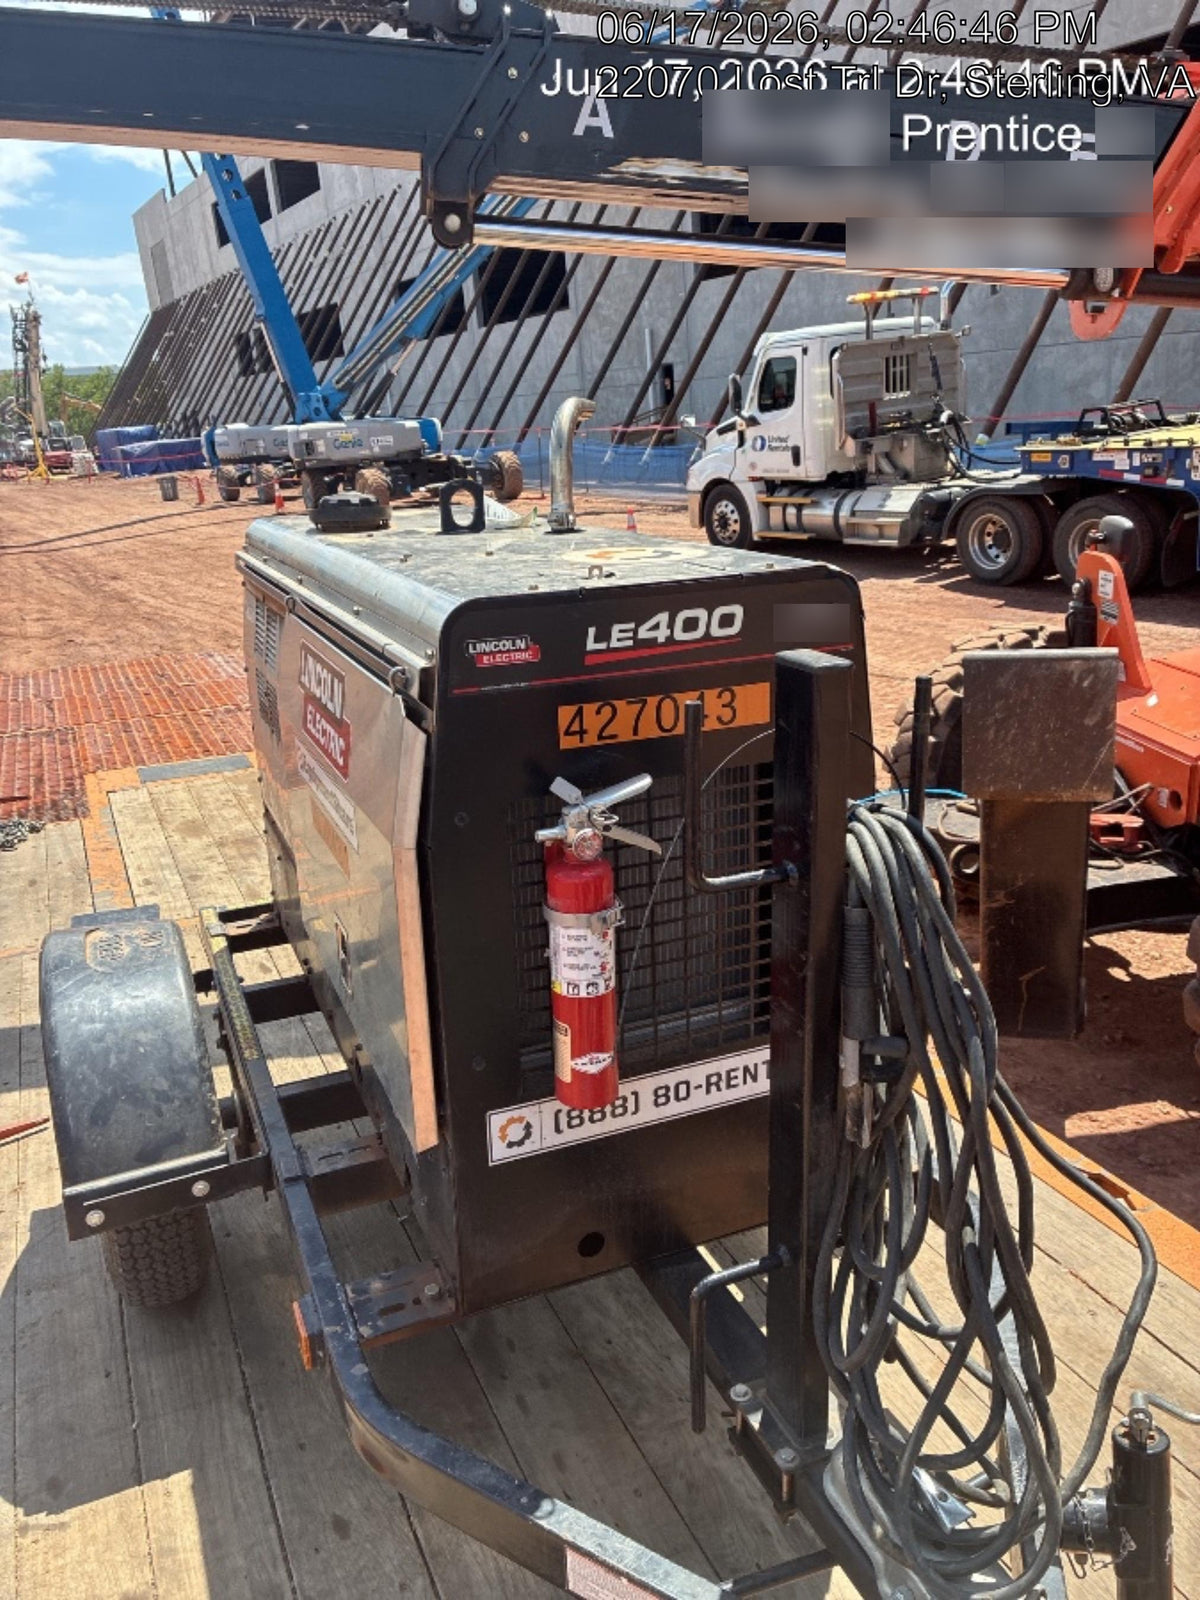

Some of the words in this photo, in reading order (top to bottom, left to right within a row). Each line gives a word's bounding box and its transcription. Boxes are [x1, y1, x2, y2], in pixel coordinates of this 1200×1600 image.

[468, 638, 528, 654] LINCOLN
[586, 604, 744, 651] LE400
[482, 650, 534, 664] ELECTRIC
[301, 650, 343, 720] LINCOLN
[306, 703, 346, 767] ELECTRIC
